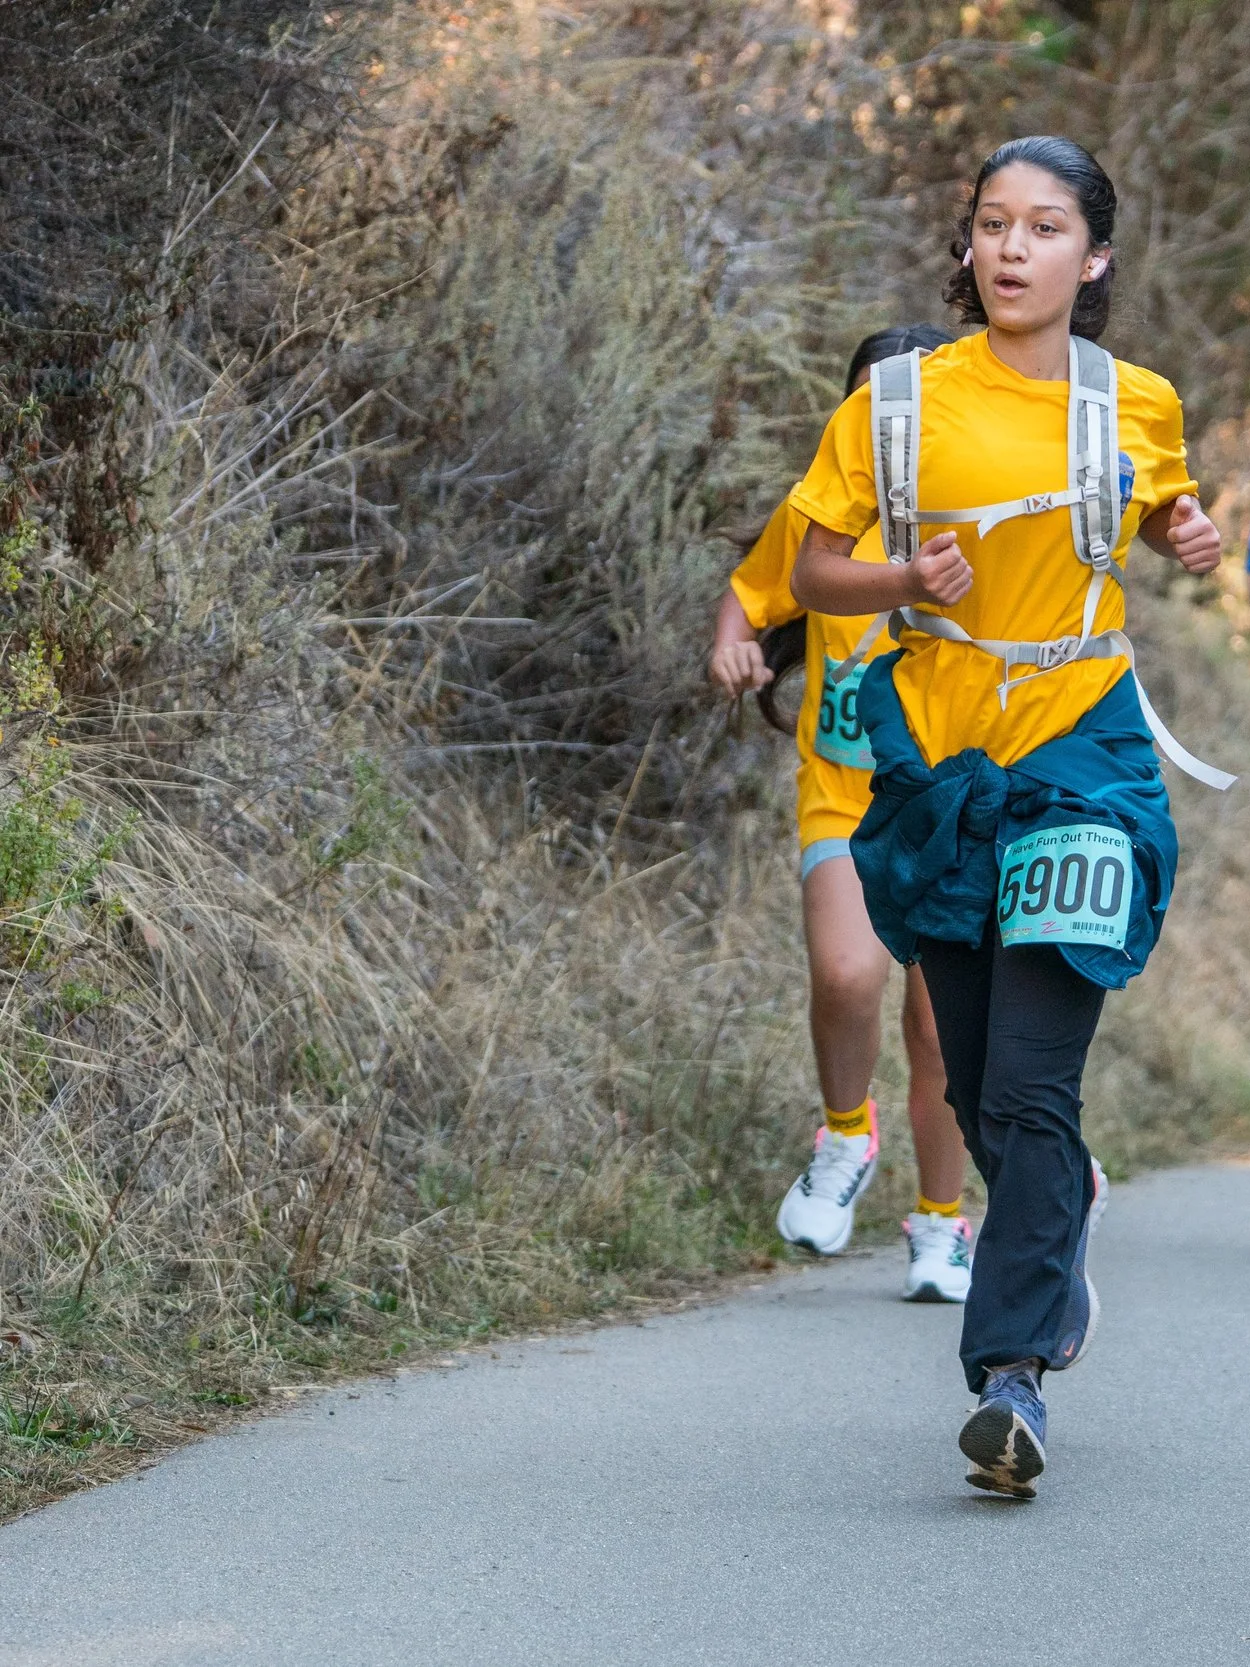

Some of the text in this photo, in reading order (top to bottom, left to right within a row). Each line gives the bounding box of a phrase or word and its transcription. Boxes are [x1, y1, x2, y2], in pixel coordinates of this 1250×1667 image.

[1012, 831, 1125, 856] Have Fun Out There!
[1000, 853, 1125, 923] 5900
